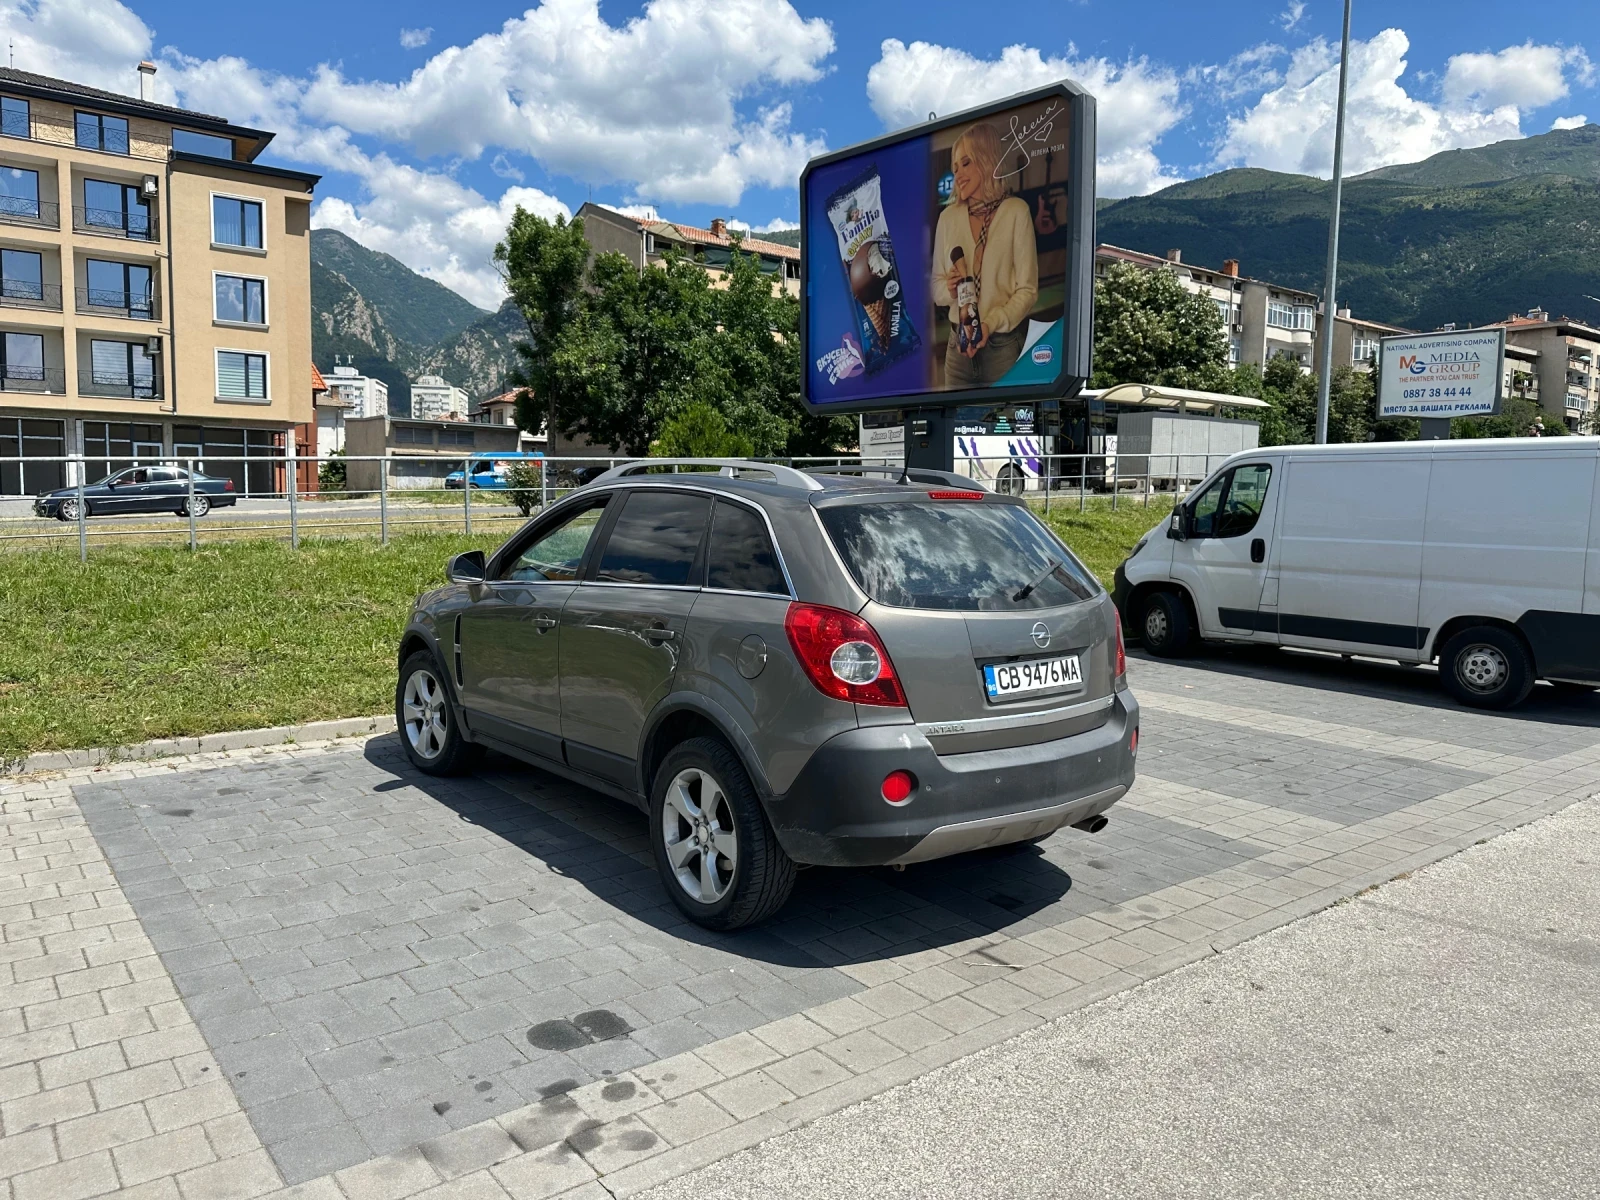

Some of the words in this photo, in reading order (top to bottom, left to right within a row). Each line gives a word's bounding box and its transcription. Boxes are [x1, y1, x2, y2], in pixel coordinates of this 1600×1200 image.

[1050, 143, 1065, 153] РОЗГА
[841, 208, 880, 244] Familia
[1386, 344, 1417, 352] NATIONAL
[1418, 340, 1462, 349] ADVERTISING
[1463, 338, 1497, 346] COMPANY
[816, 347, 846, 373] ВКУСЕН
[1430, 352, 1480, 362] MEDIA
[1429, 362, 1481, 374] GROUP
[1409, 375, 1435, 383] PARTNER
[1403, 388, 1426, 399] 0887
[1428, 388, 1441, 398] 38
[1443, 387, 1456, 397] 44
[1459, 386, 1472, 397] 44
[1383, 405, 1407, 414] МЯСТО
[1408, 404, 1419, 412] ЗА
[1420, 404, 1452, 412] ВАШАТА
[1454, 403, 1491, 411] РЕКЛАМА
[997, 665, 1021, 690] CB
[1022, 661, 1060, 687] 9476
[1060, 658, 1079, 682] MA
[926, 724, 961, 734] ANTARA
